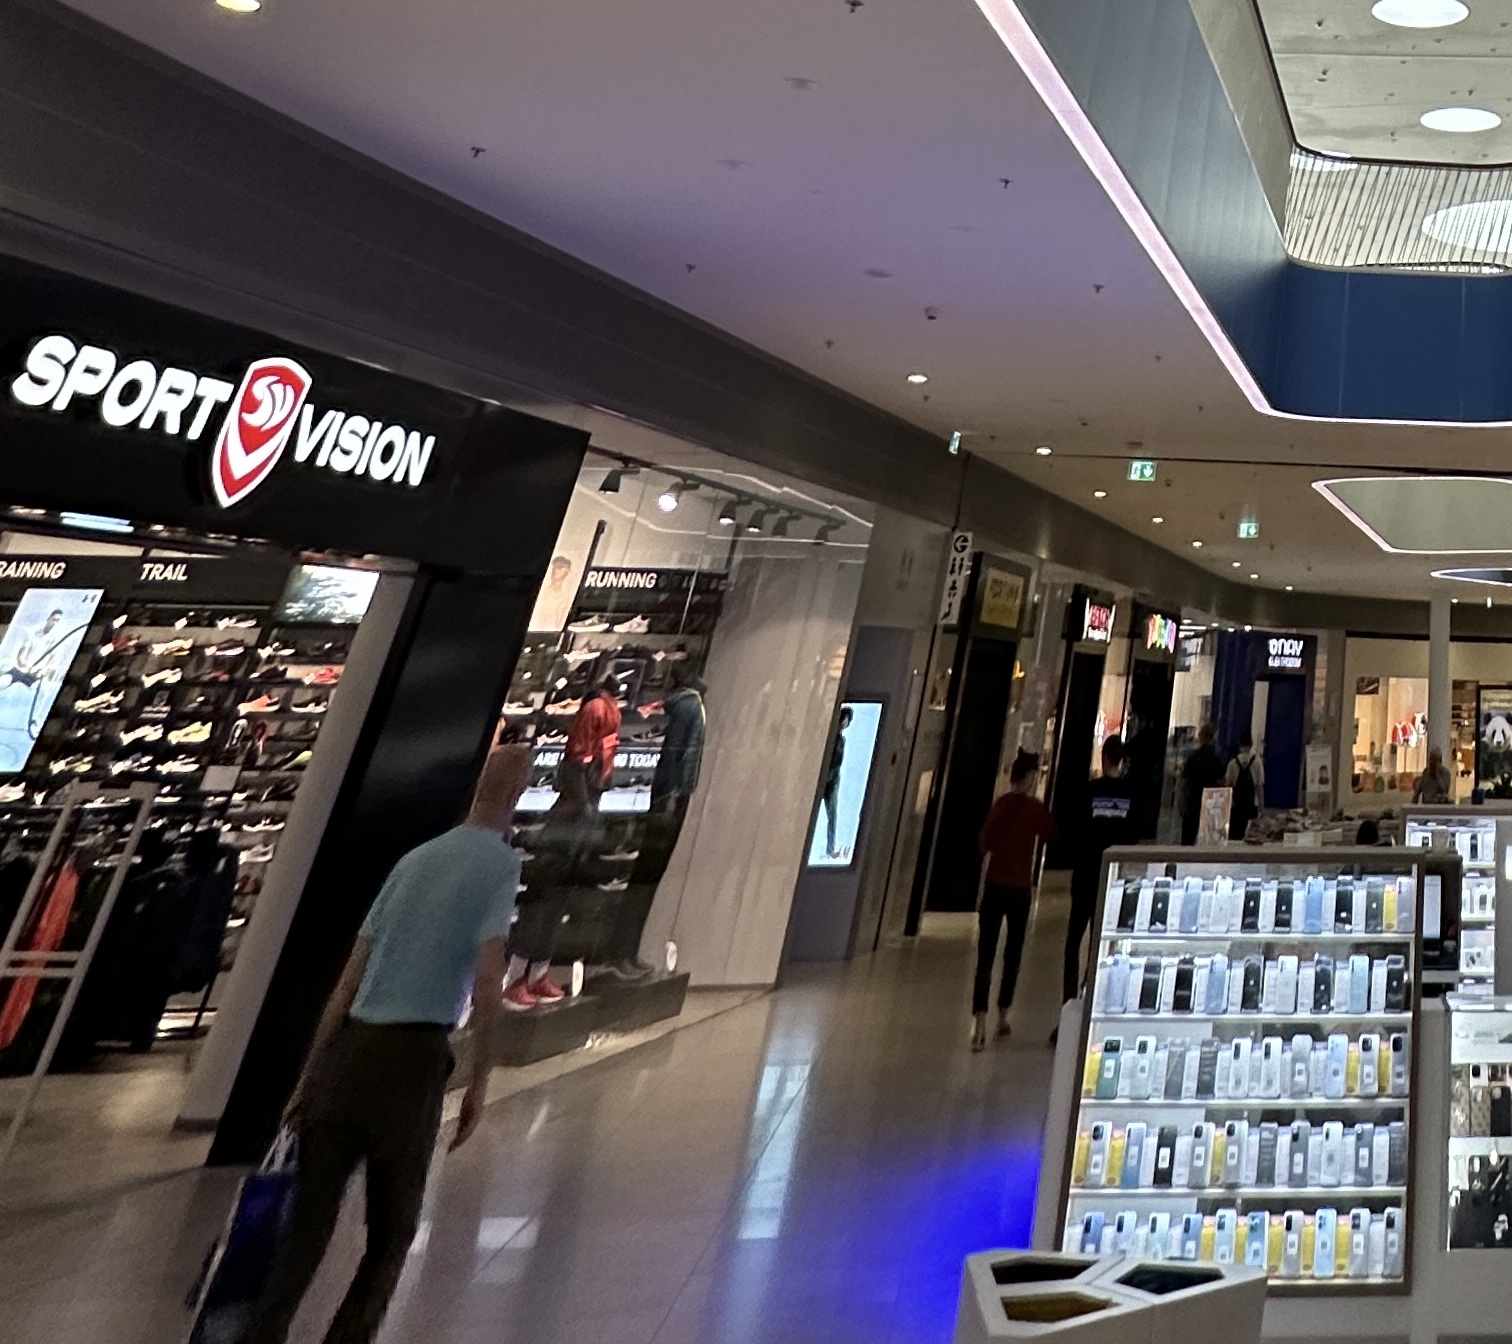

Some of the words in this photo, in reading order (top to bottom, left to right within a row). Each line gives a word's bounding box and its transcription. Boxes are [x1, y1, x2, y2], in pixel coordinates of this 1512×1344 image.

[12, 335, 234, 440] SPORT
[294, 403, 436, 486] VISION
[140, 563, 188, 581] TRAIL
[585, 570, 658, 589] RUNNING
